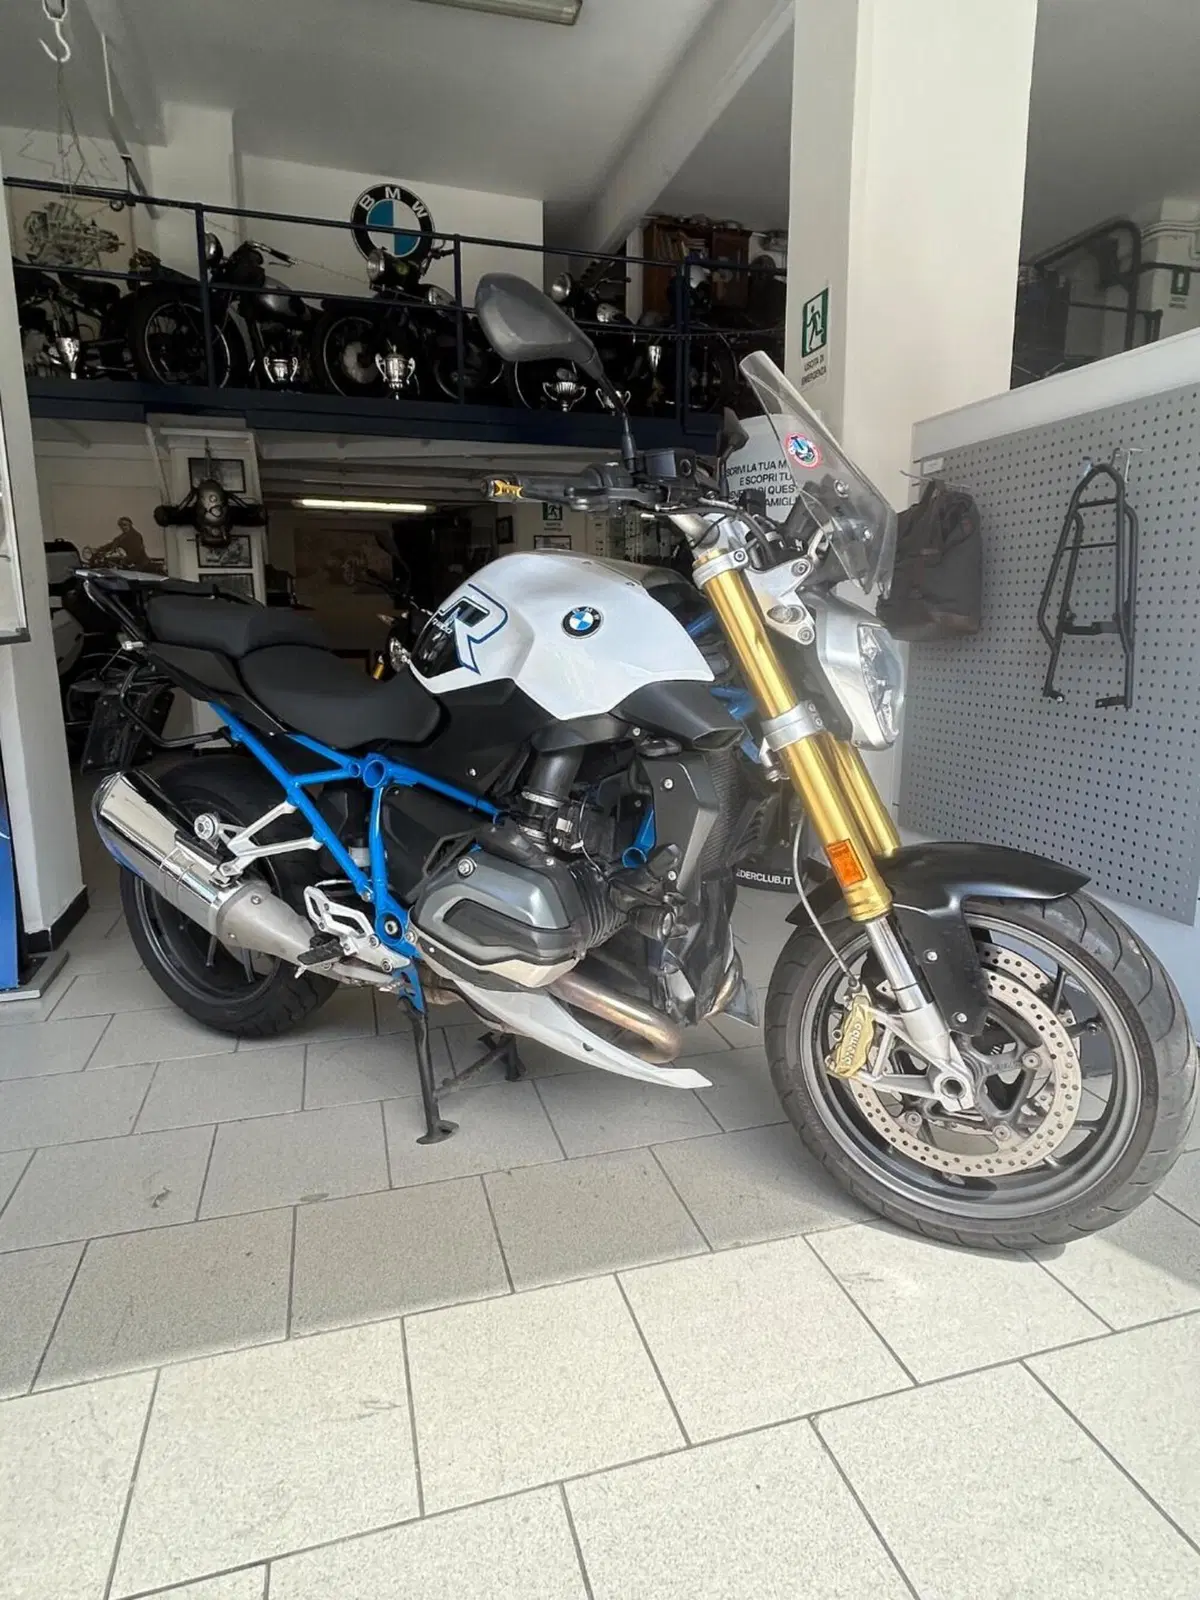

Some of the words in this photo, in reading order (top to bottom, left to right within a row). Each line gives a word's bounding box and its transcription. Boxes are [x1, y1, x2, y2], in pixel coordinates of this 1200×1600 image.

[359, 186, 428, 218] BMW
[725, 464, 746, 477] SCRIVI
[746, 463, 757, 473] LA
[758, 460, 776, 470] TUA
[739, 477, 745, 486] E
[745, 473, 778, 485] SCOPRI
[779, 471, 793, 481] TU
[768, 484, 796, 495] QUES
[764, 497, 796, 507] AMIGL
[843, 1021, 862, 1066] brembo
